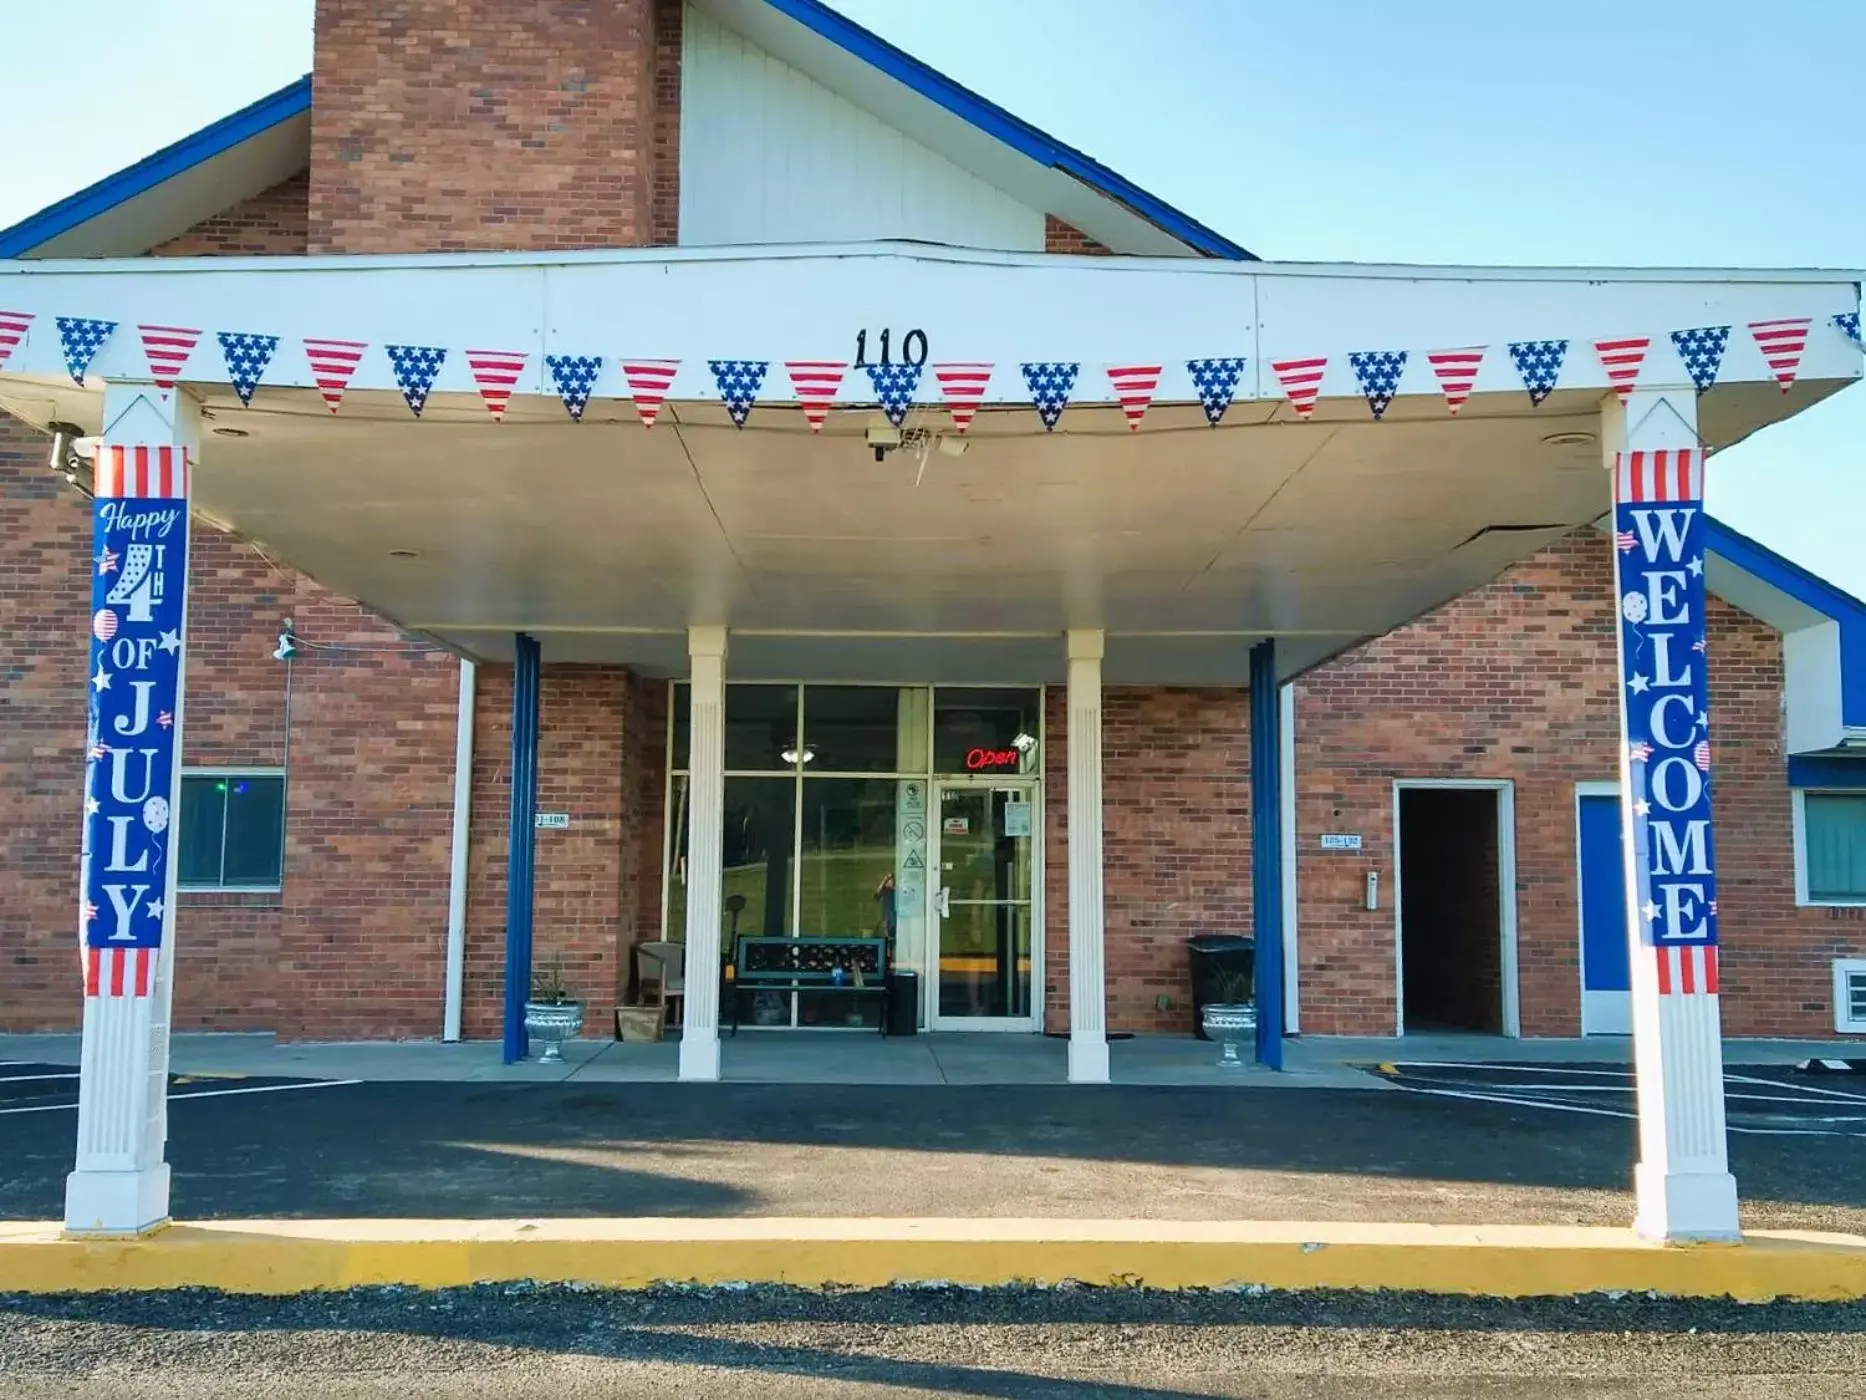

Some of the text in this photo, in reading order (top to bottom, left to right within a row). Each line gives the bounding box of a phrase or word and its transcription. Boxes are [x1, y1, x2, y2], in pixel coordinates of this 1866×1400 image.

[856, 328, 928, 366] 110
[99, 501, 180, 541] Happy
[111, 637, 159, 670] OF
[1629, 507, 1713, 940] WELCOME
[967, 748, 1017, 769] Open
[101, 680, 159, 941] JULY
